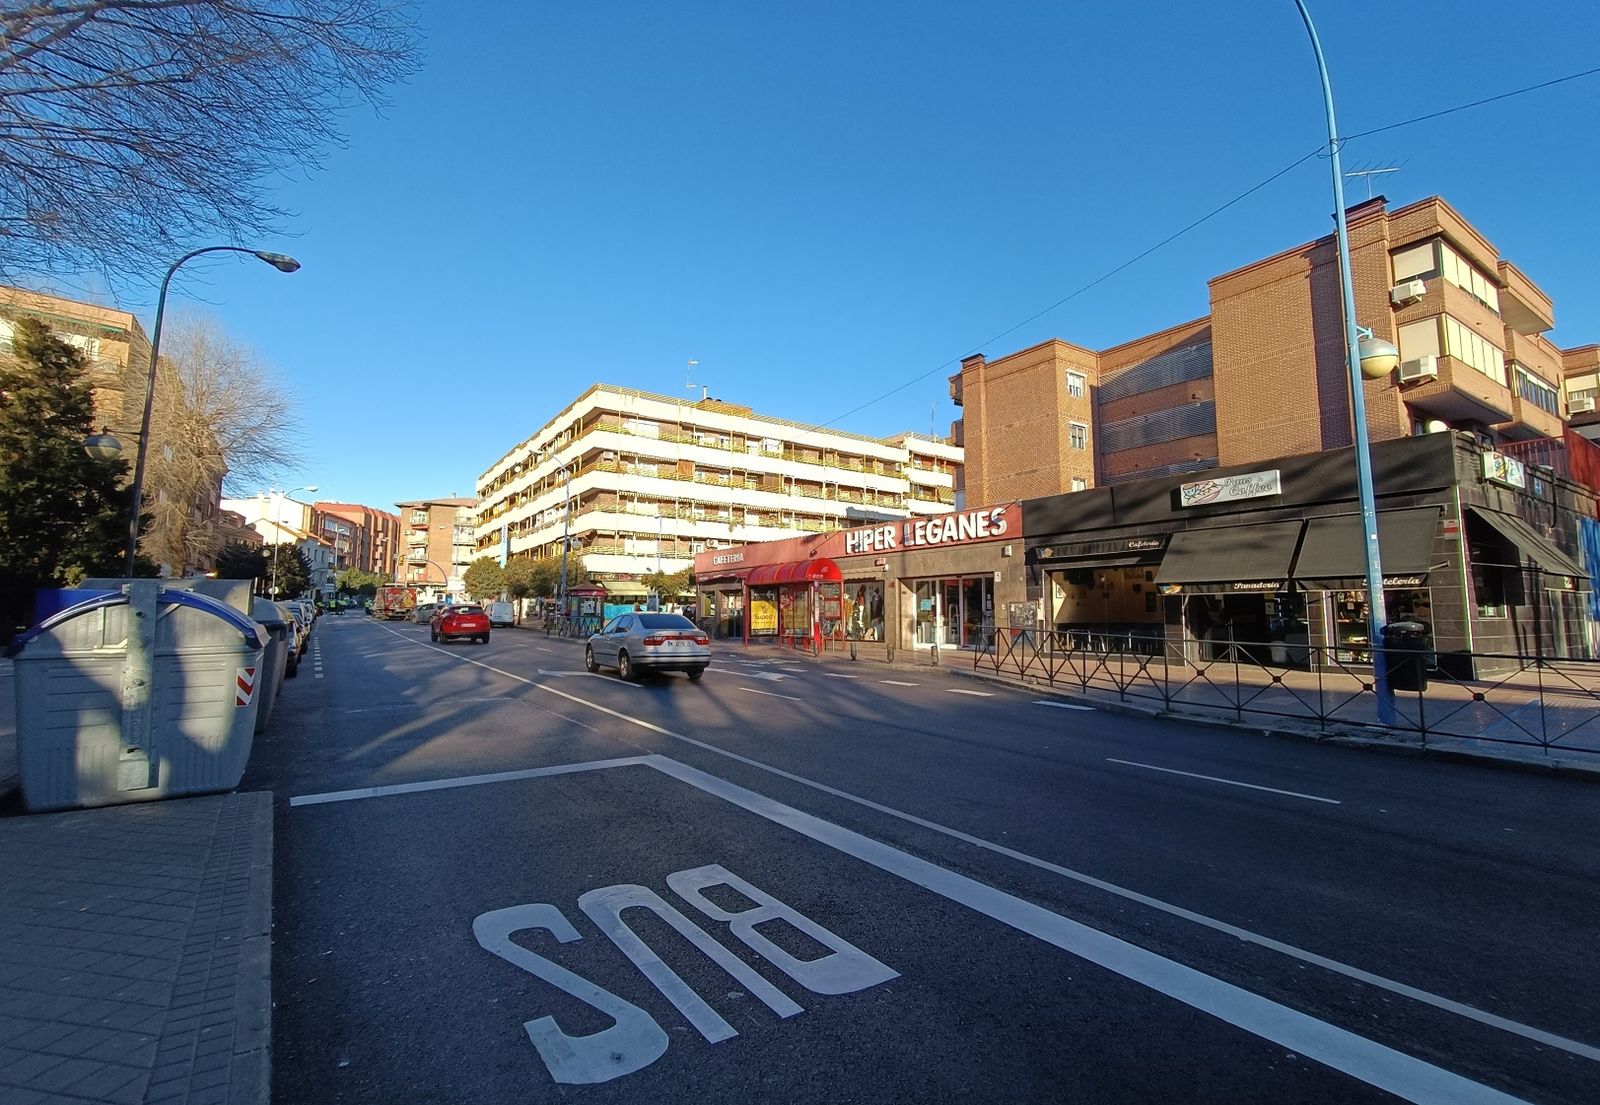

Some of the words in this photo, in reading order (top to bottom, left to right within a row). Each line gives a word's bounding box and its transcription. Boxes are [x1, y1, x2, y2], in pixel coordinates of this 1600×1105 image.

[1229, 482, 1272, 497] Coffee
[845, 525, 896, 554] HIPER
[903, 507, 1008, 547] LEGANES
[472, 864, 901, 1084] BUS
